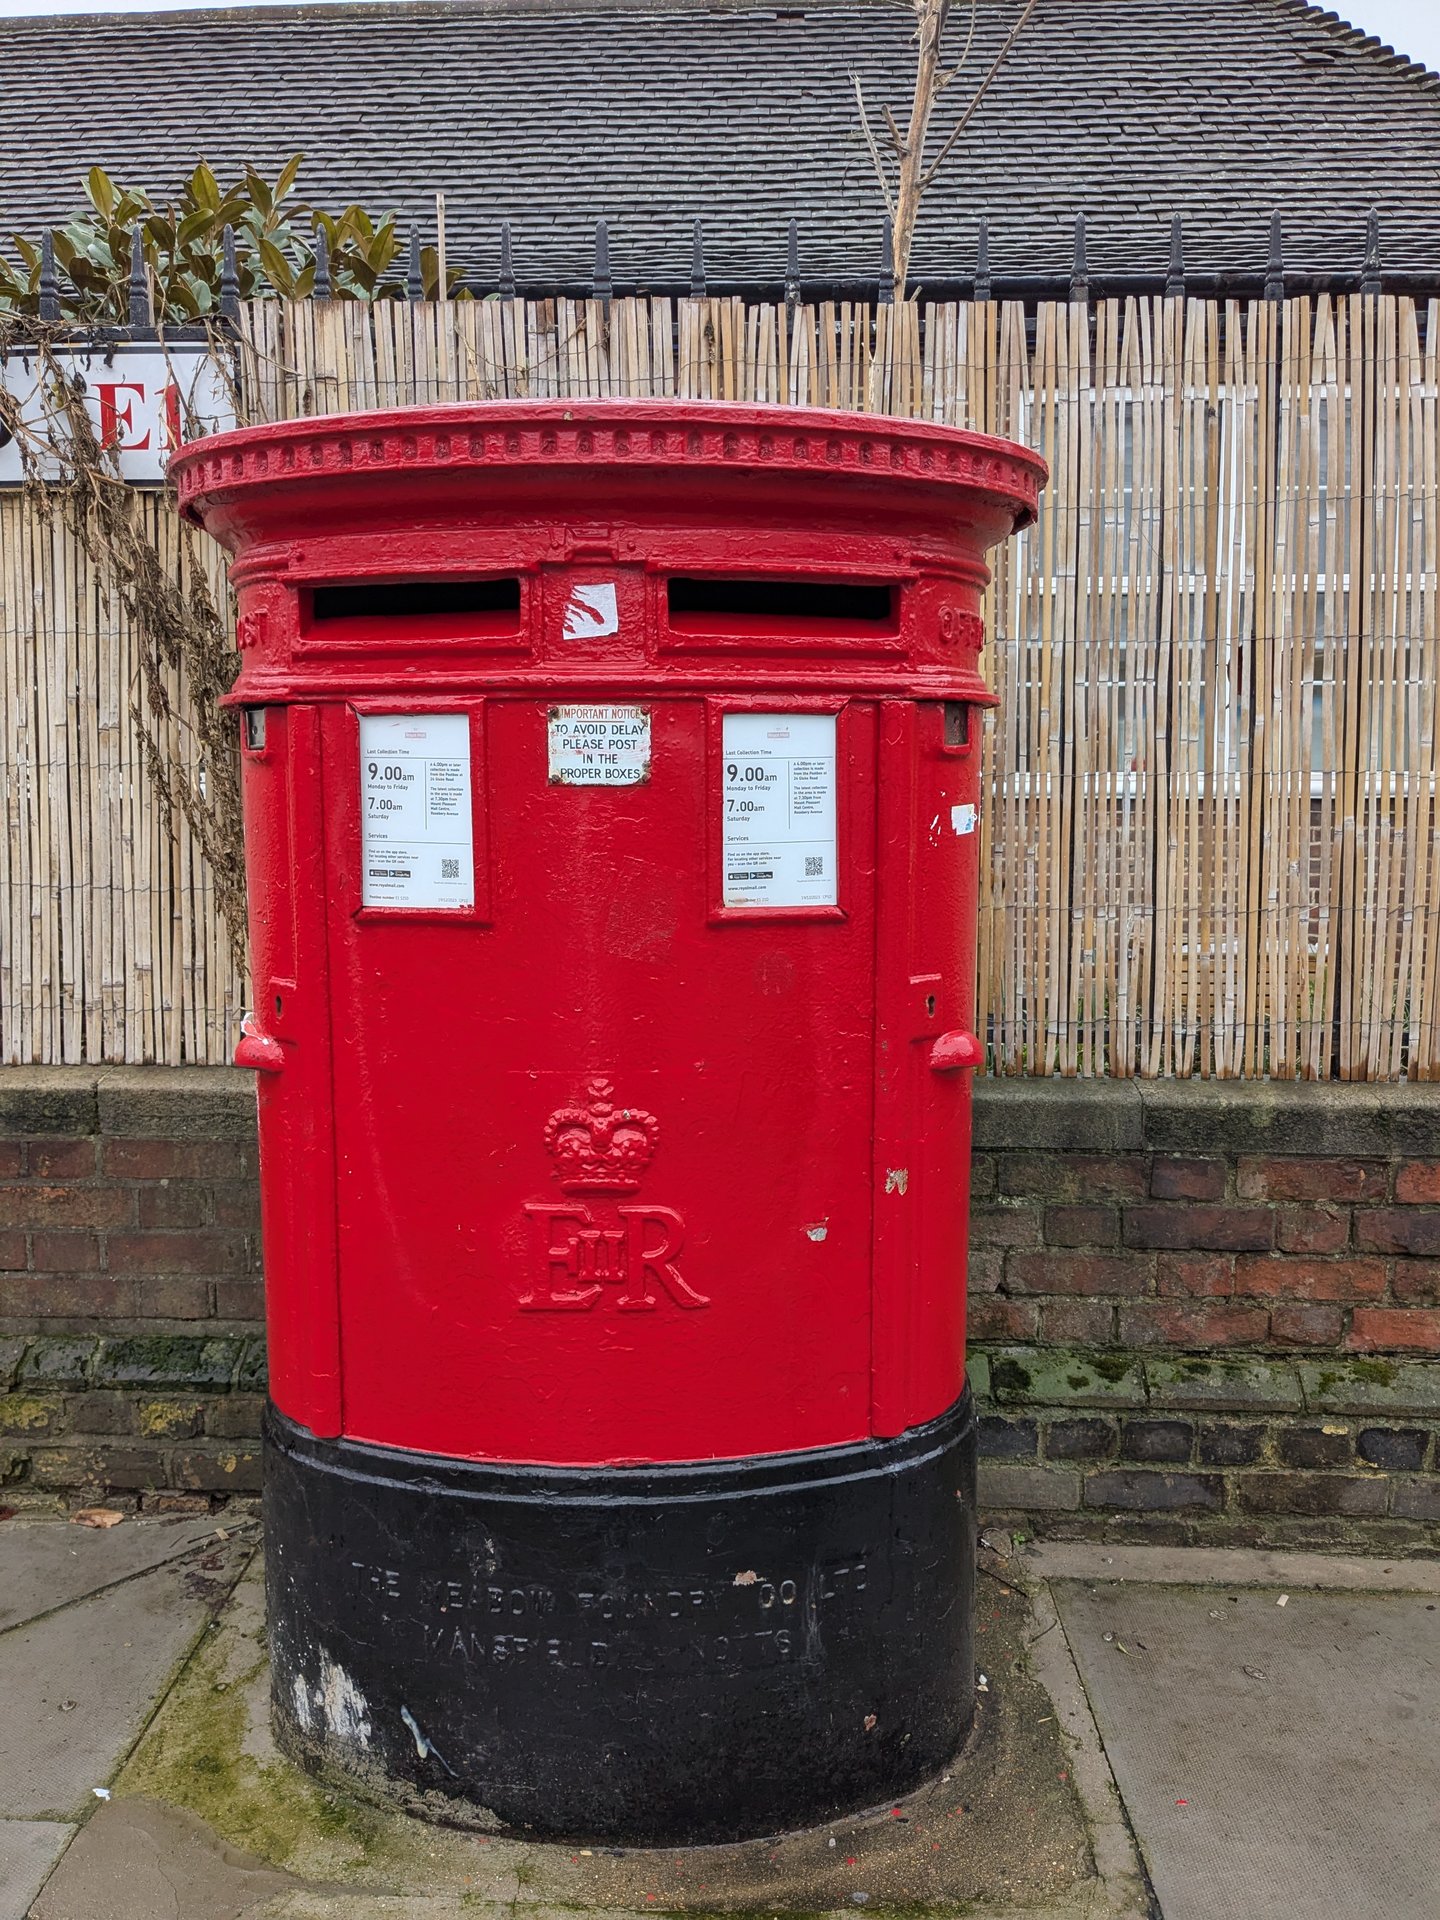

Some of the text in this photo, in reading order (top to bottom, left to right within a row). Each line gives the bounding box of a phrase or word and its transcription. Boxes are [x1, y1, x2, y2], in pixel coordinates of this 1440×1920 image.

[562, 709, 640, 719] IMPORTANT NOTICE
[555, 724, 644, 735] TO AVOID DELAY
[563, 739, 637, 750] PLEASE POST
[583, 754, 618, 764] IN THE
[368, 763, 415, 781] 9.00am
[561, 768, 640, 779] PROPER BOXES
[727, 764, 777, 782] 9.00am
[368, 797, 402, 810] 7.00am
[727, 799, 765, 812] 7.00am
